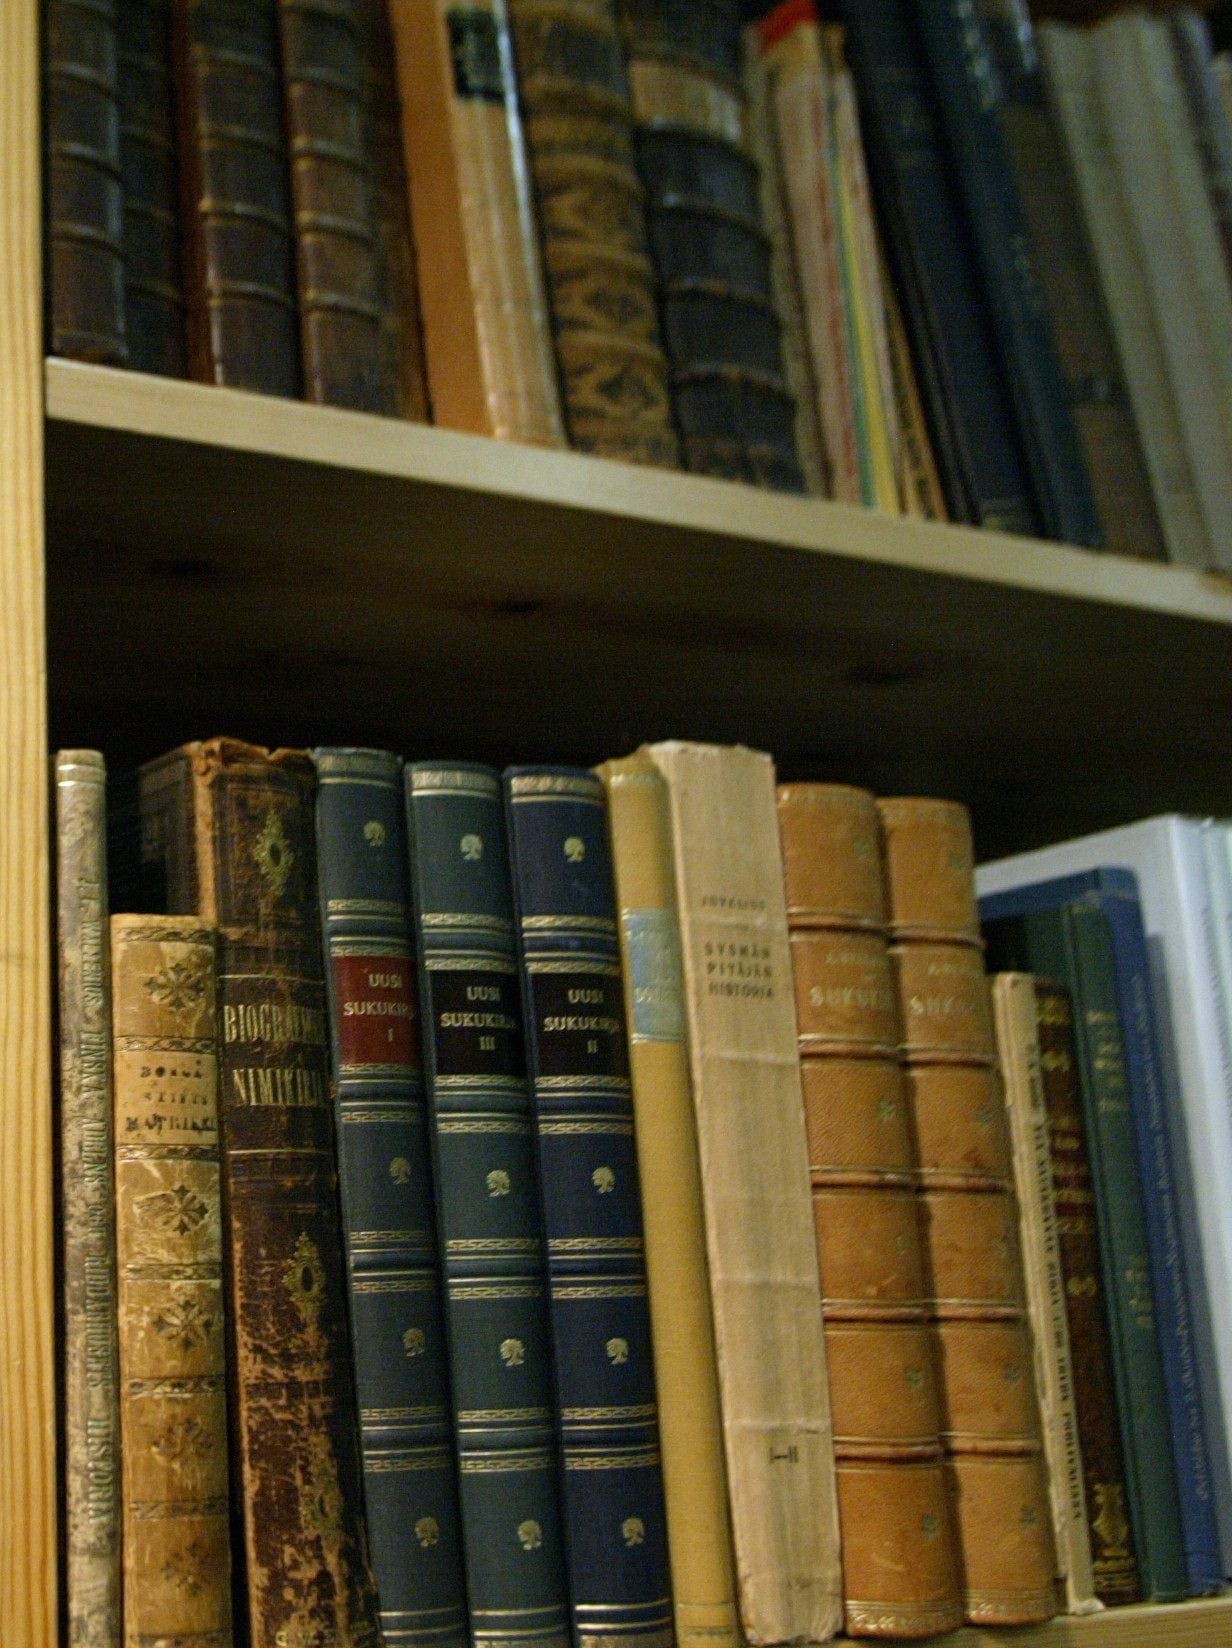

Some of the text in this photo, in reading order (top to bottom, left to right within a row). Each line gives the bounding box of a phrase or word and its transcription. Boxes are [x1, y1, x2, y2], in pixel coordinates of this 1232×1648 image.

[368, 972, 402, 987] UUSI
[466, 985, 501, 1001] UUSI
[567, 988, 603, 1004] UUSI
[479, 1036, 496, 1051] III
